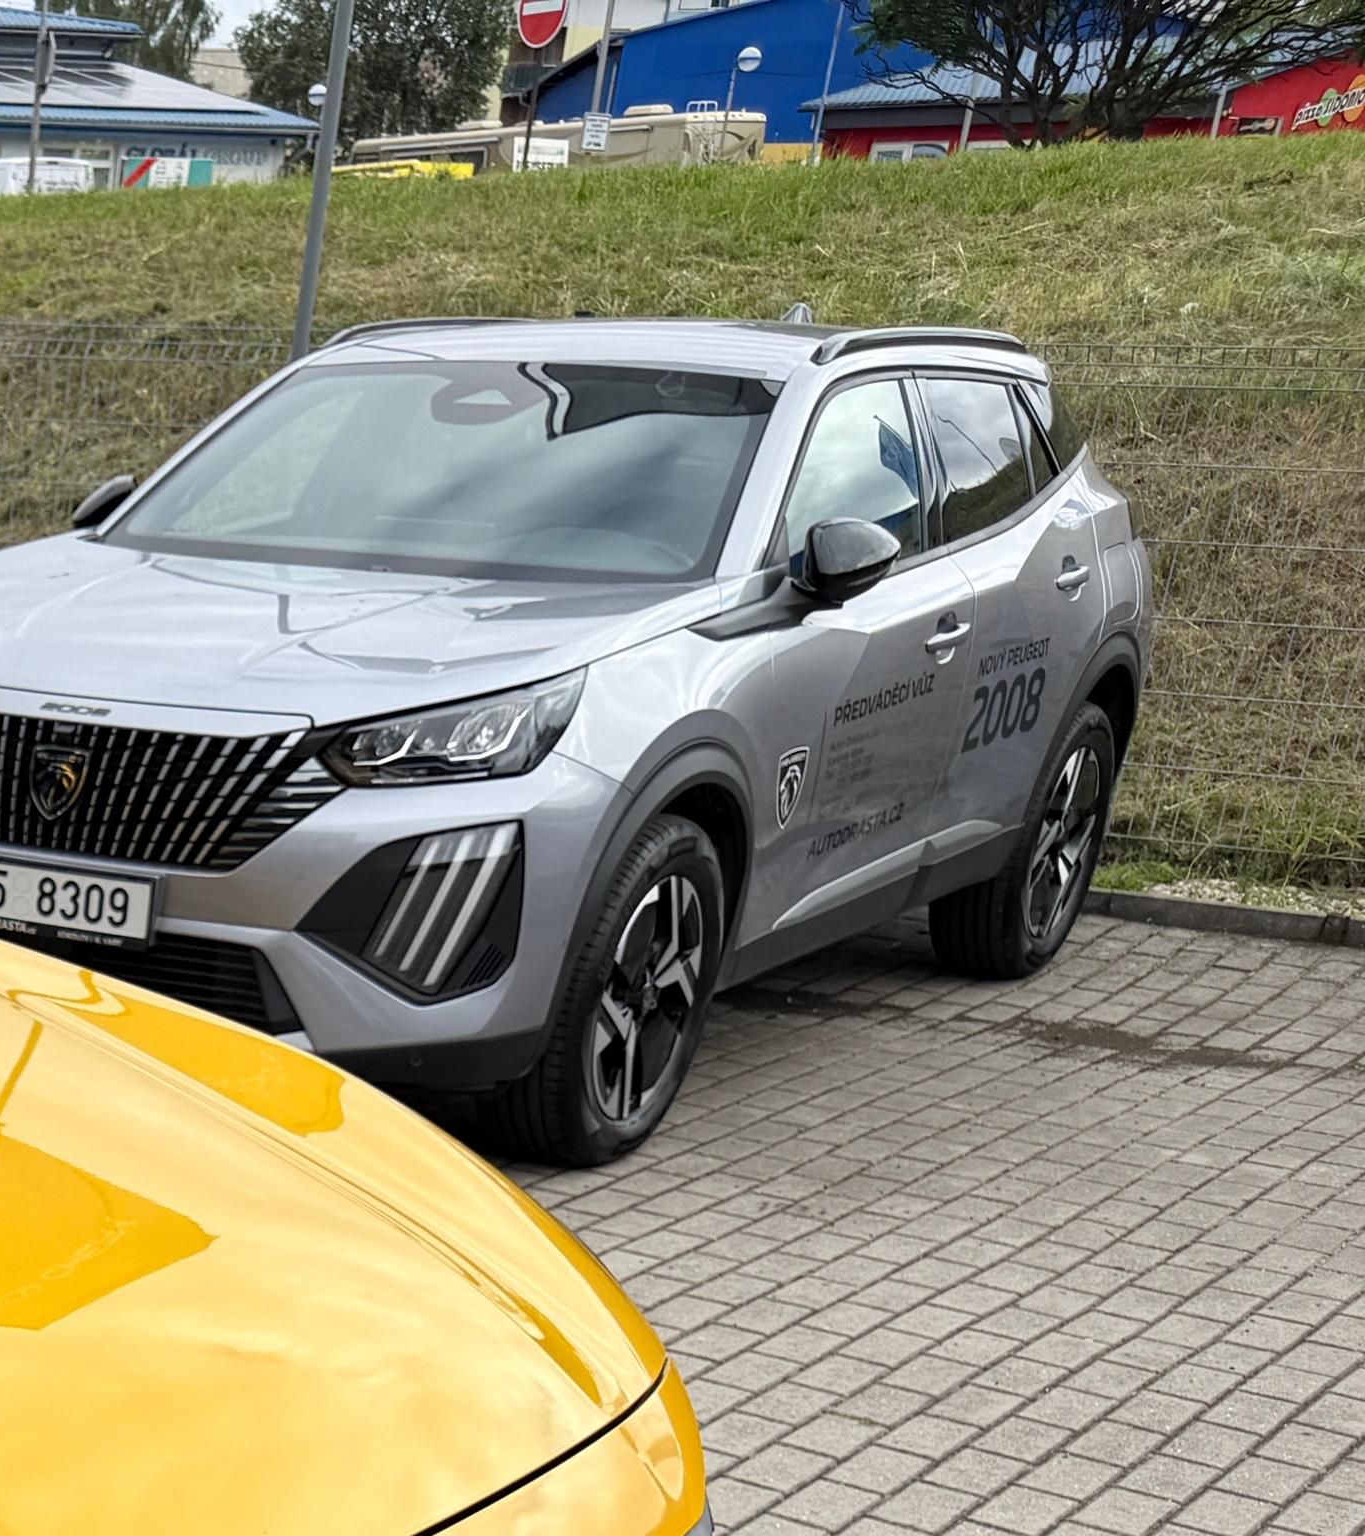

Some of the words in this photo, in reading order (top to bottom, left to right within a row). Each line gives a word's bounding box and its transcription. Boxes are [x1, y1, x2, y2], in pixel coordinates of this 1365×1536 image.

[1006, 637, 1051, 667] PEUGEOT
[832, 677, 912, 728] PŘEDVÁDĚCÍ
[961, 667, 1047, 753] 2008
[36, 876, 130, 928] 8309
